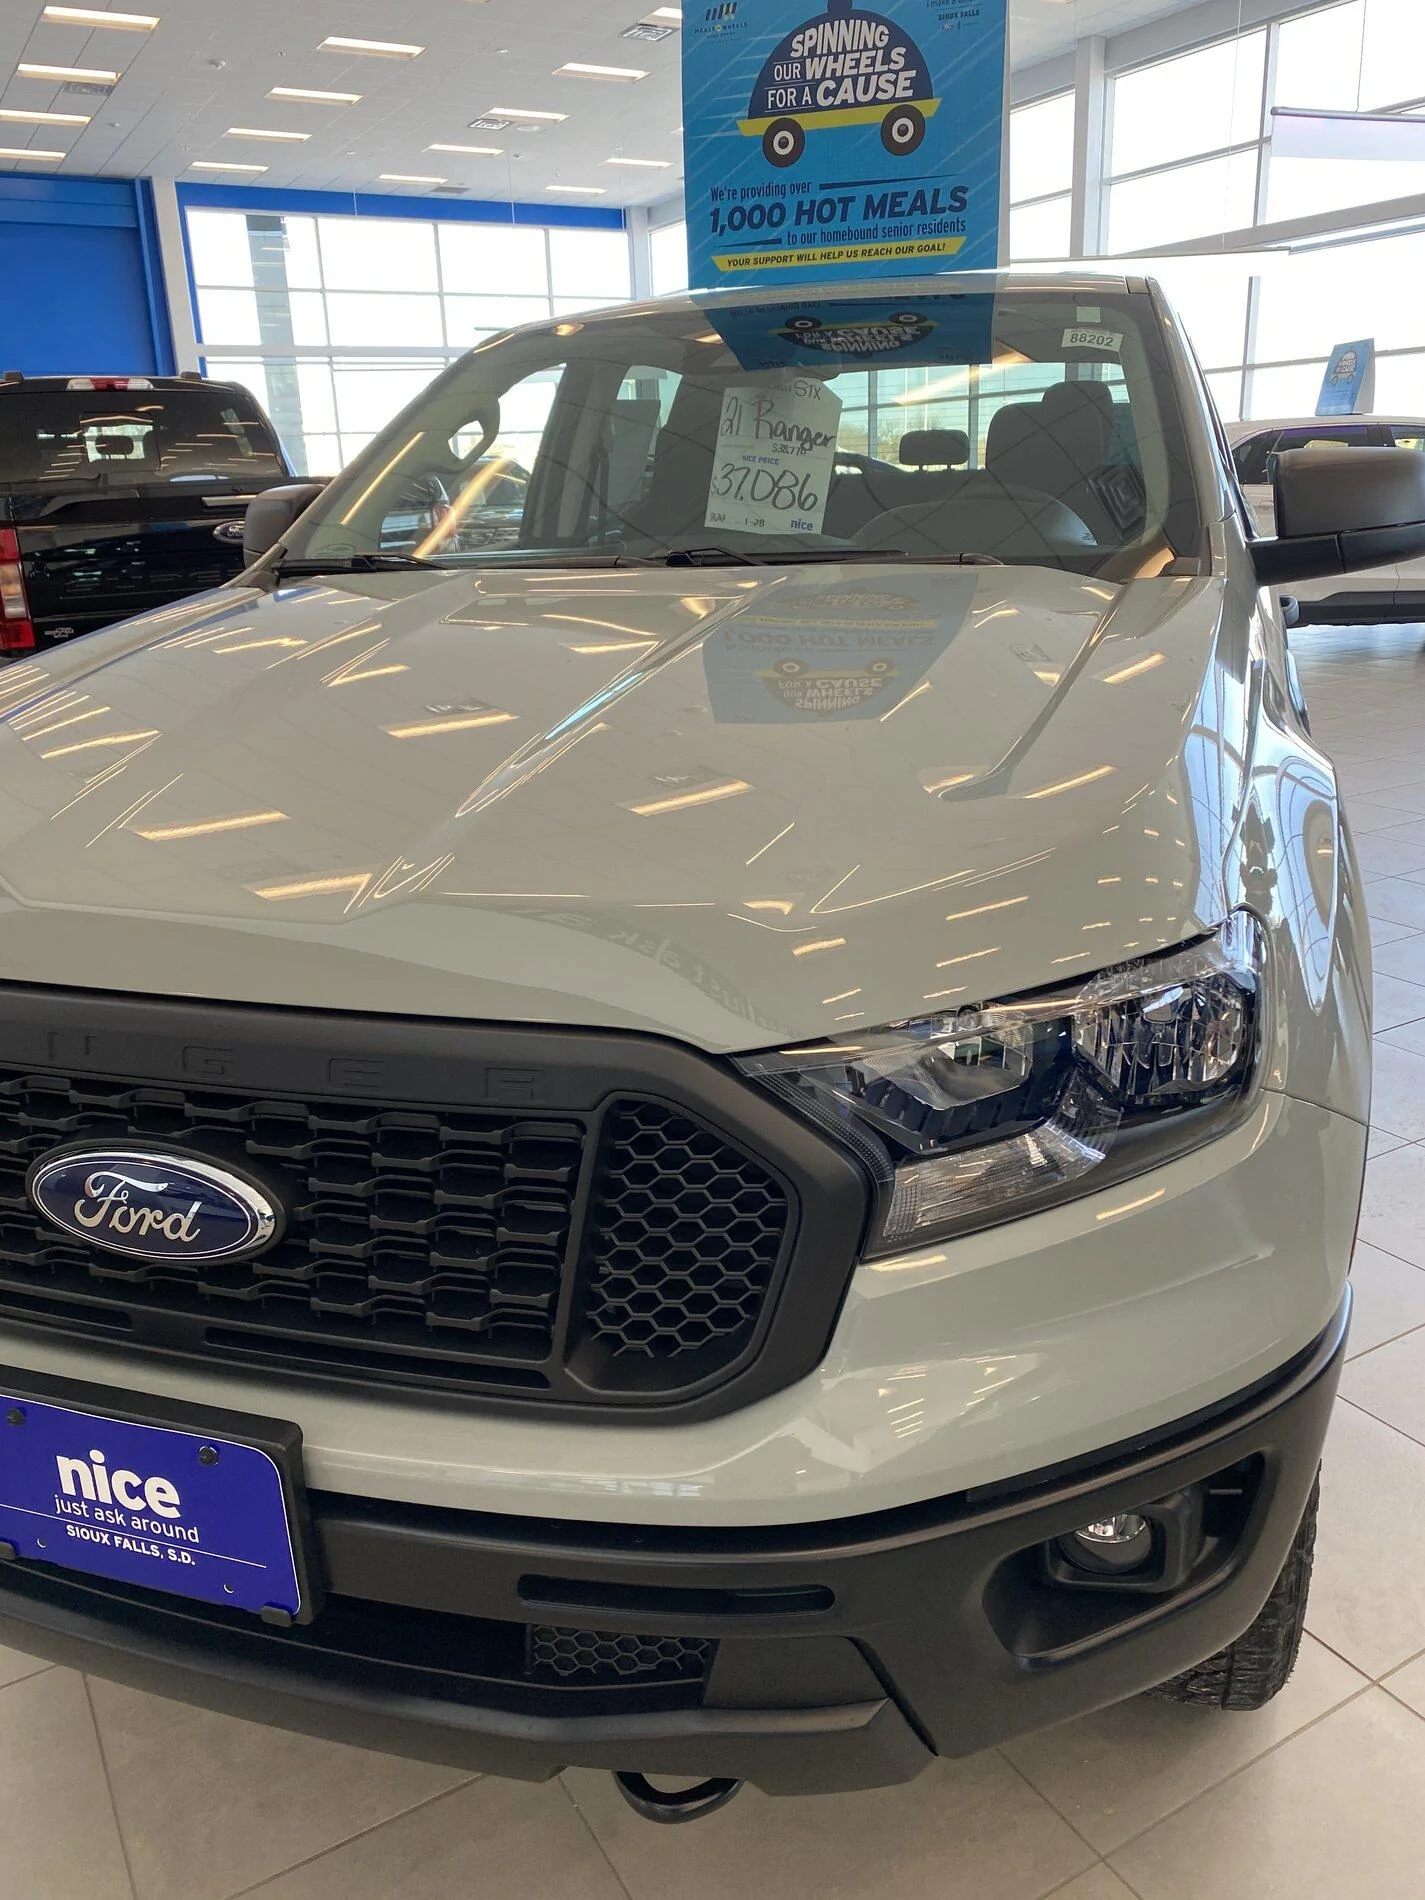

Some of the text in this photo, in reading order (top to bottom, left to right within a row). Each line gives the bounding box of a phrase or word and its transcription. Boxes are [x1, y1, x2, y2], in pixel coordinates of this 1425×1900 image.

[938, 9, 980, 21] SIOUX FALLS
[790, 19, 890, 58] SPINNING
[774, 46, 907, 82] OUR WHEELS
[767, 70, 917, 109] FOR A CAUSE
[710, 181, 812, 204] We're providing over
[710, 185, 970, 237] 1,000 HOT MEALS
[787, 217, 966, 246] to our homebound senior residents
[727, 243, 946, 267] YOUR SUPPORT WILL HELP US REACH OUR GOAL!
[1070, 333, 1114, 347] 88202
[793, 379, 821, 401] STX
[720, 396, 837, 451] 21 Ranger
[741, 454, 780, 466] NICE PRICE
[790, 518, 814, 532] nice
[73, 1169, 203, 1245] Ford
[55, 1449, 182, 1519] nice
[54, 1494, 200, 1545] just ask around
[66, 1524, 197, 1566] SIOUX FALLS, S.D.
